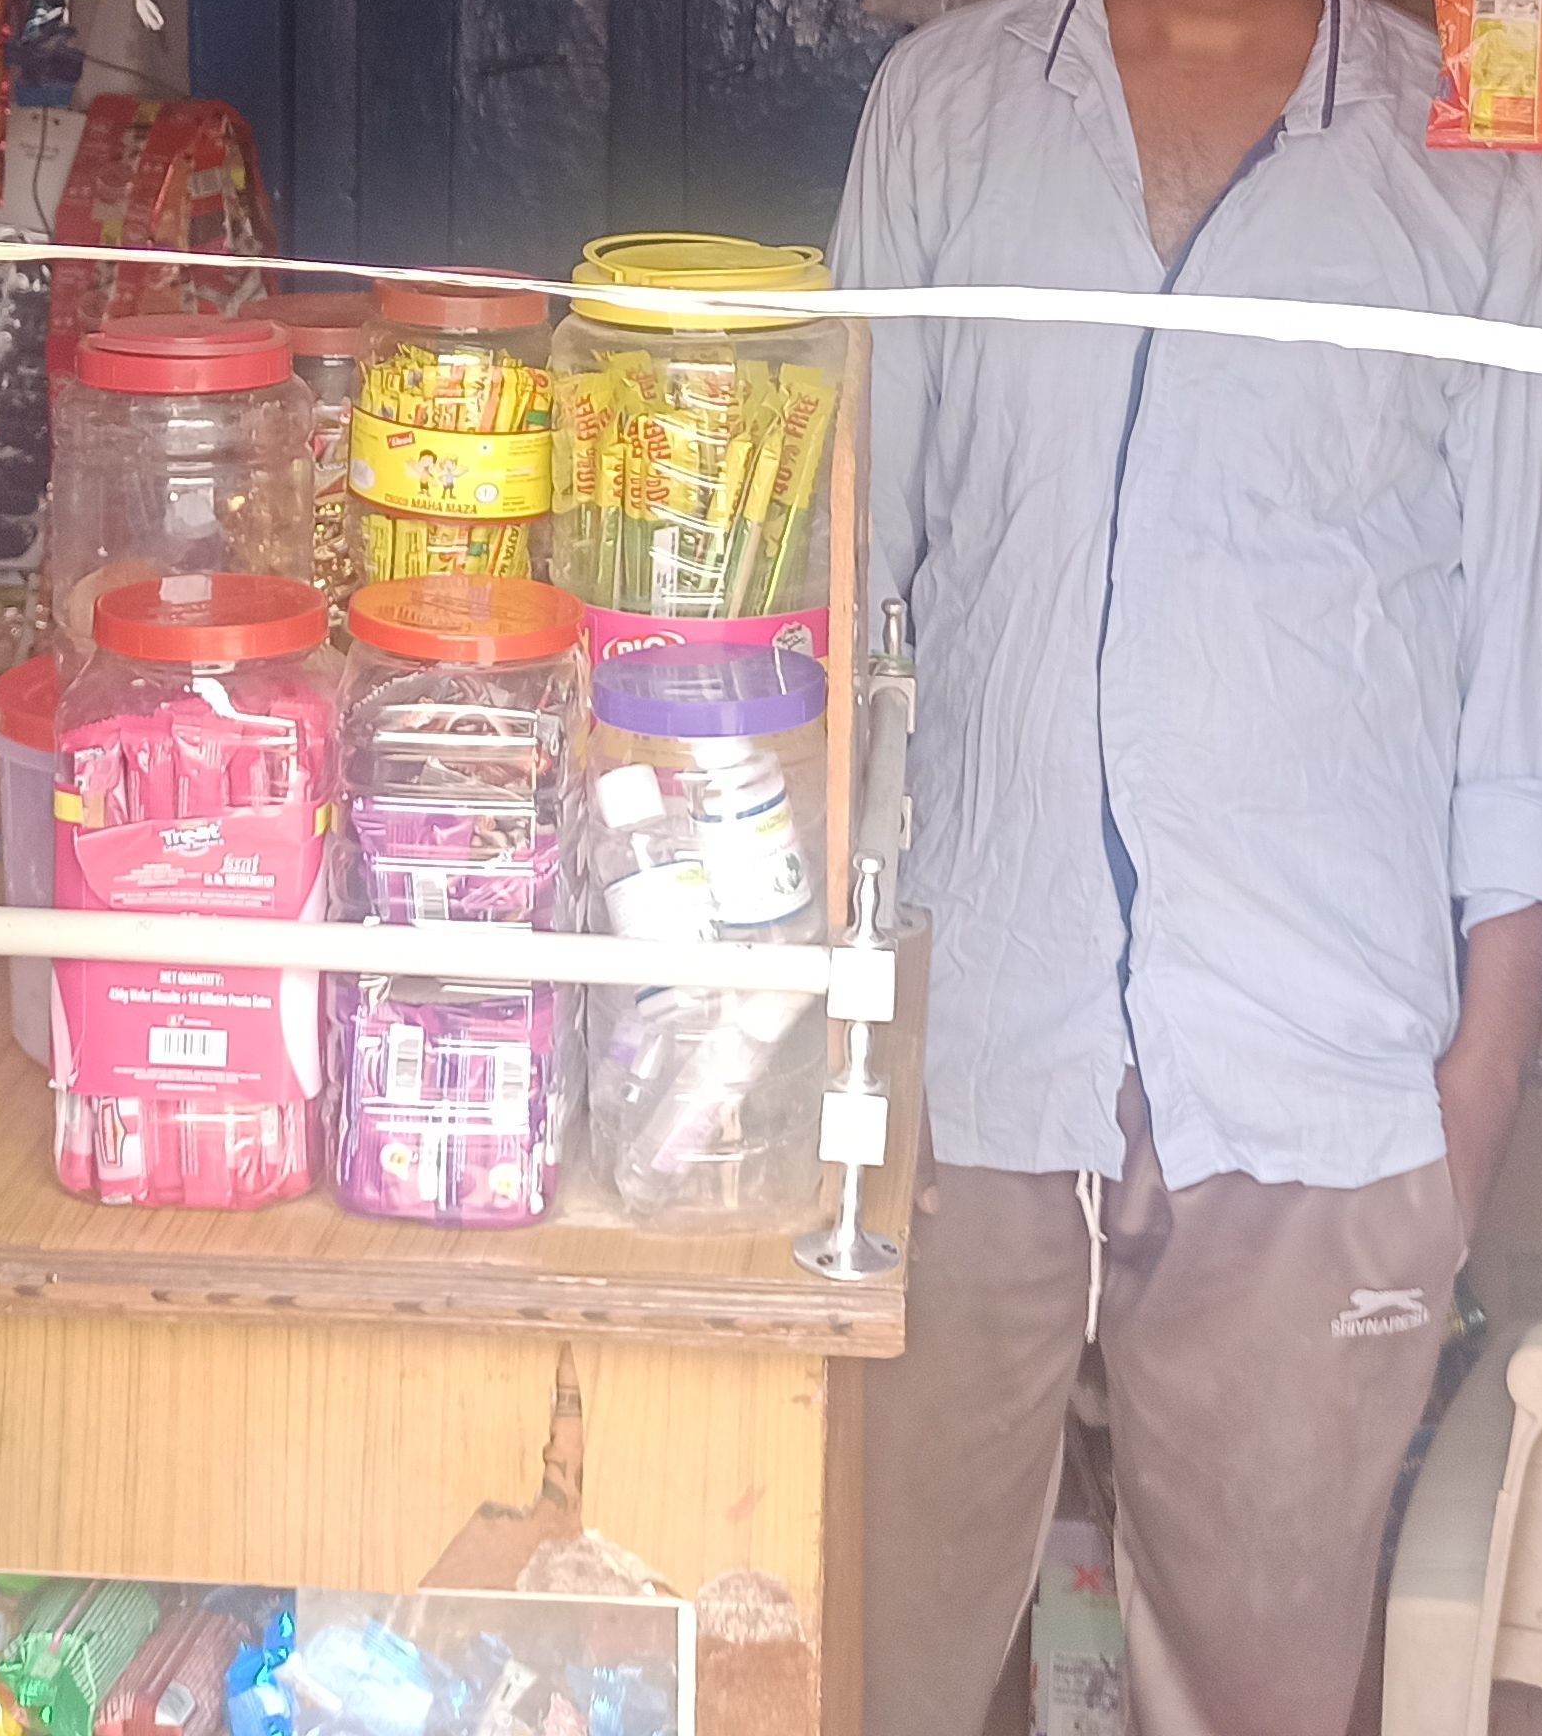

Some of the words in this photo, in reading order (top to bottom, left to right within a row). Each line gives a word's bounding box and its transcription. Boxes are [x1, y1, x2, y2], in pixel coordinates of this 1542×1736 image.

[786, 393, 820, 439] FREE
[410, 497, 444, 513] MAHA
[446, 503, 478, 515] MAZA
